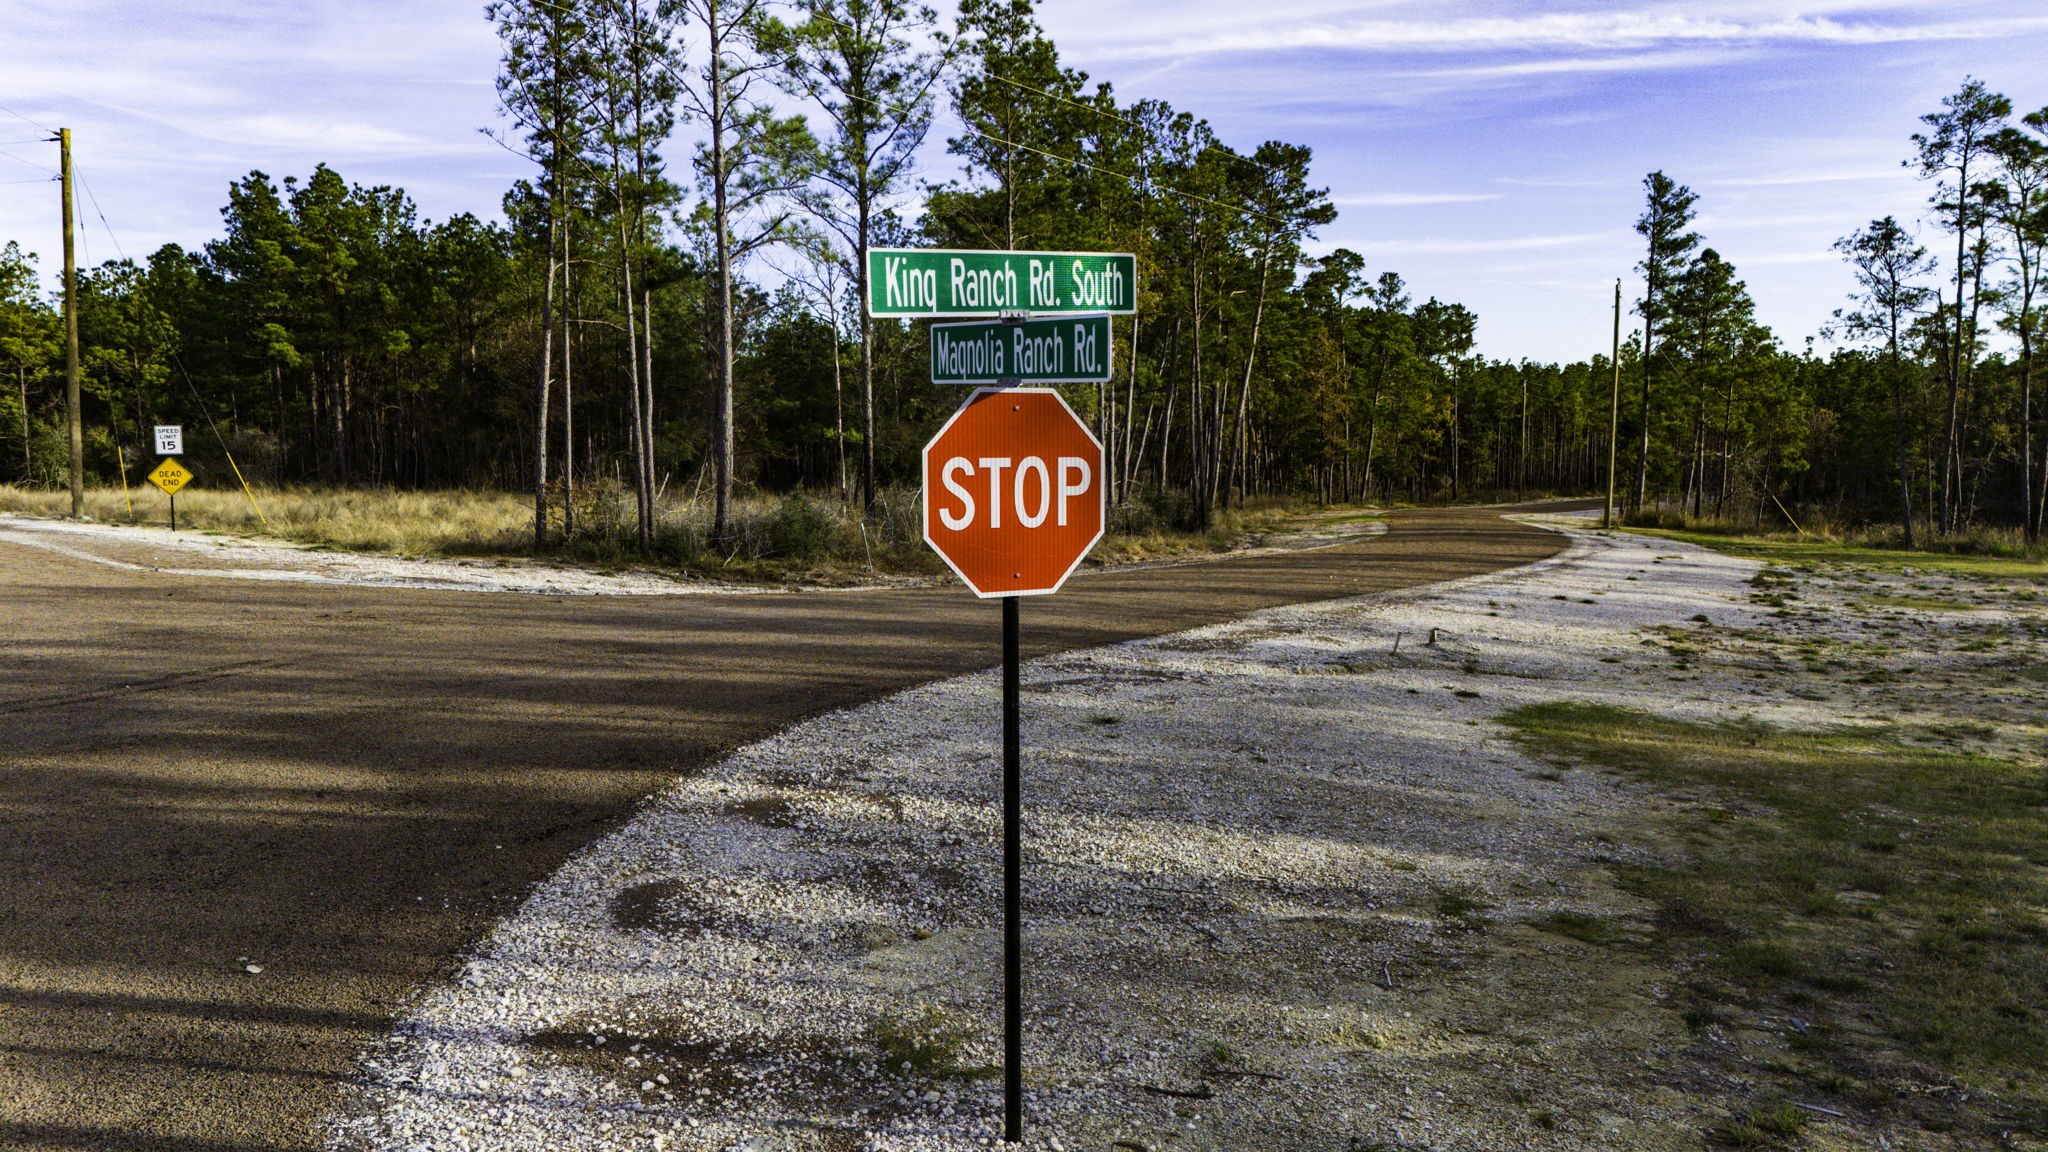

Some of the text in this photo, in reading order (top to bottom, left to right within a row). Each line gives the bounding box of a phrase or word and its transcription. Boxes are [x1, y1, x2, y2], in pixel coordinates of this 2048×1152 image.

[885, 256, 1123, 313] King Ranch Rd. South
[937, 323, 1102, 380] Magnolia Ranch Rd.
[161, 440, 176, 450] 15
[938, 455, 1092, 531] STOP
